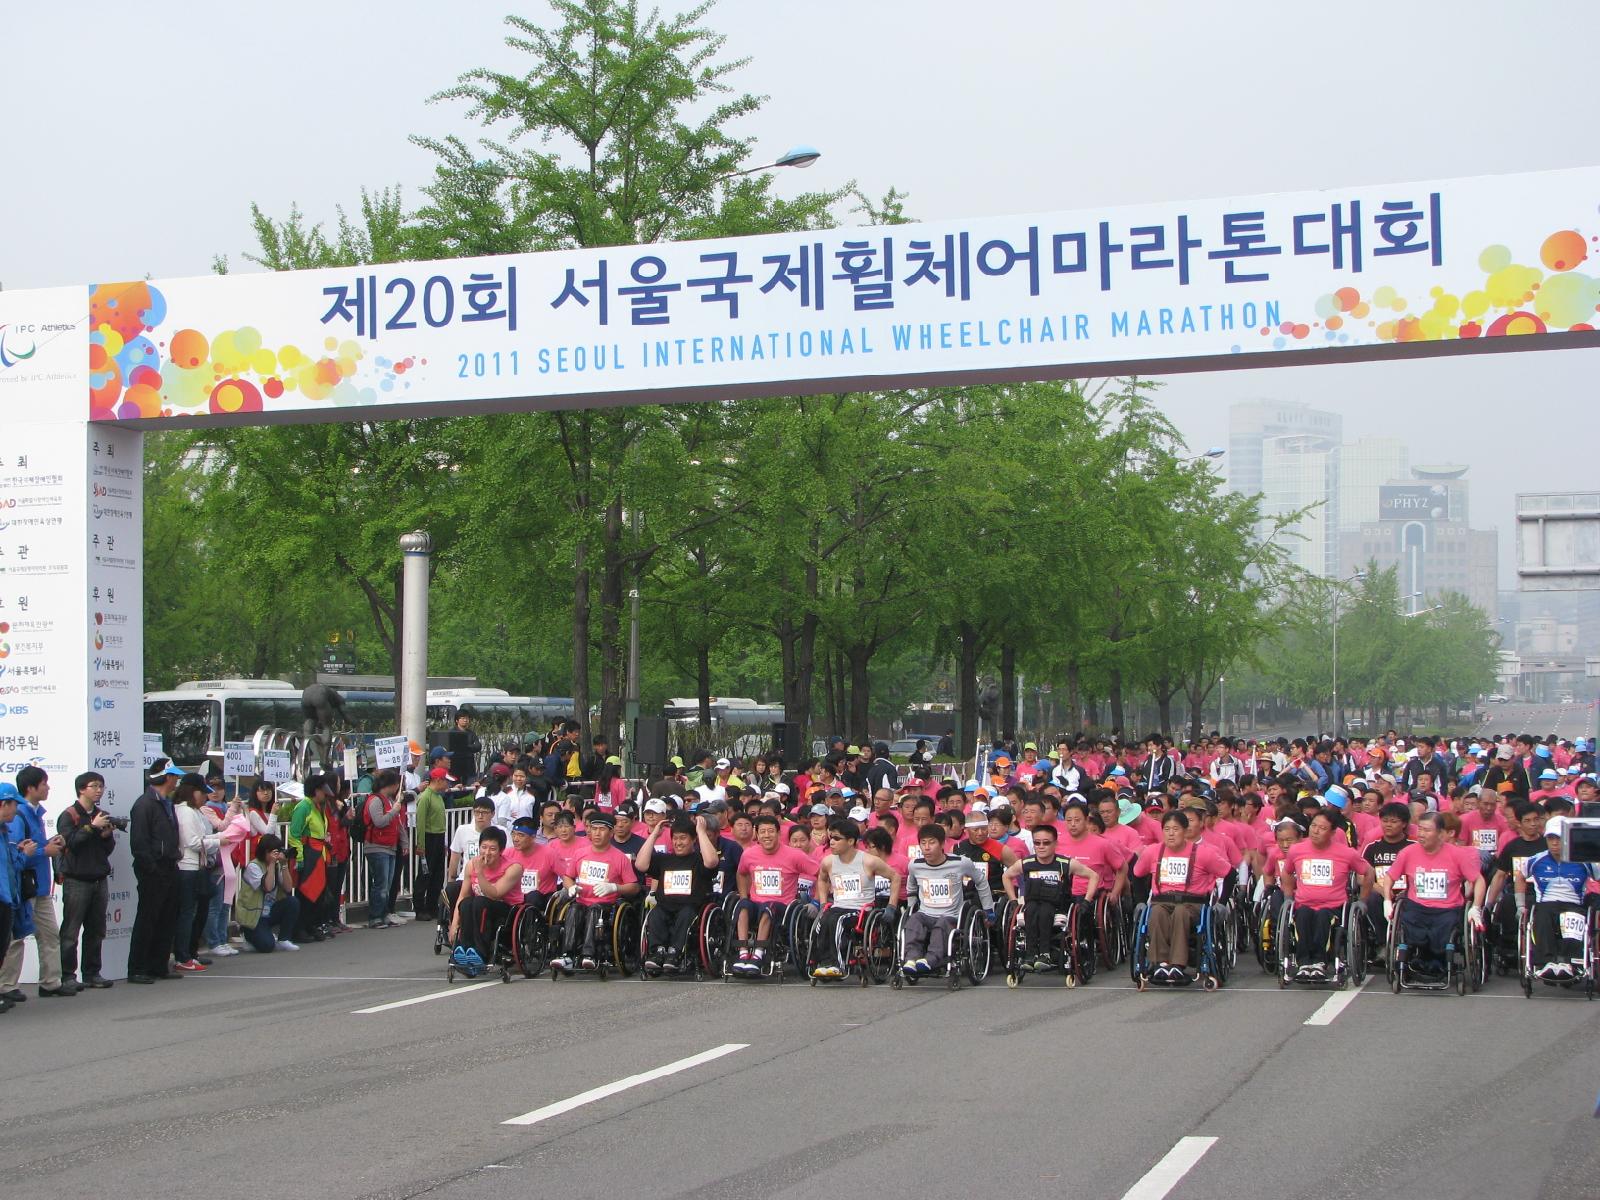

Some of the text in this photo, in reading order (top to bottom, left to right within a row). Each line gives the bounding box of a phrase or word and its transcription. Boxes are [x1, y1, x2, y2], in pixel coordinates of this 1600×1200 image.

[319, 192, 1443, 340] 제20회 서울국제휠체어마라톤대회
[15, 323, 76, 334] IPC Athletics
[457, 300, 1282, 379] 2011 SEOUL INTERNATIONAL WHEELCHAIR MARATHON
[92, 441, 100, 457] 주
[17, 455, 28, 469] 최
[92, 534, 115, 551] 주 관
[18, 544, 29, 560] 관
[107, 587, 115, 603] 원
[18, 596, 28, 611] 원
[7, 664, 46, 676] 서울특별시
[9, 705, 29, 715] KBS
[102, 699, 115, 709] KBS
[93, 730, 121, 747] 재정후원
[226, 751, 242, 761] 4001
[1480, 832, 1496, 845] 3554
[587, 866, 606, 879] 3002
[1168, 861, 1187, 876] 3503
[1311, 864, 1331, 878] 3509
[762, 874, 779, 888] 3006
[1425, 876, 1445, 890] 1514
[930, 884, 949, 897] 3008
[1565, 917, 1585, 933] 3510
